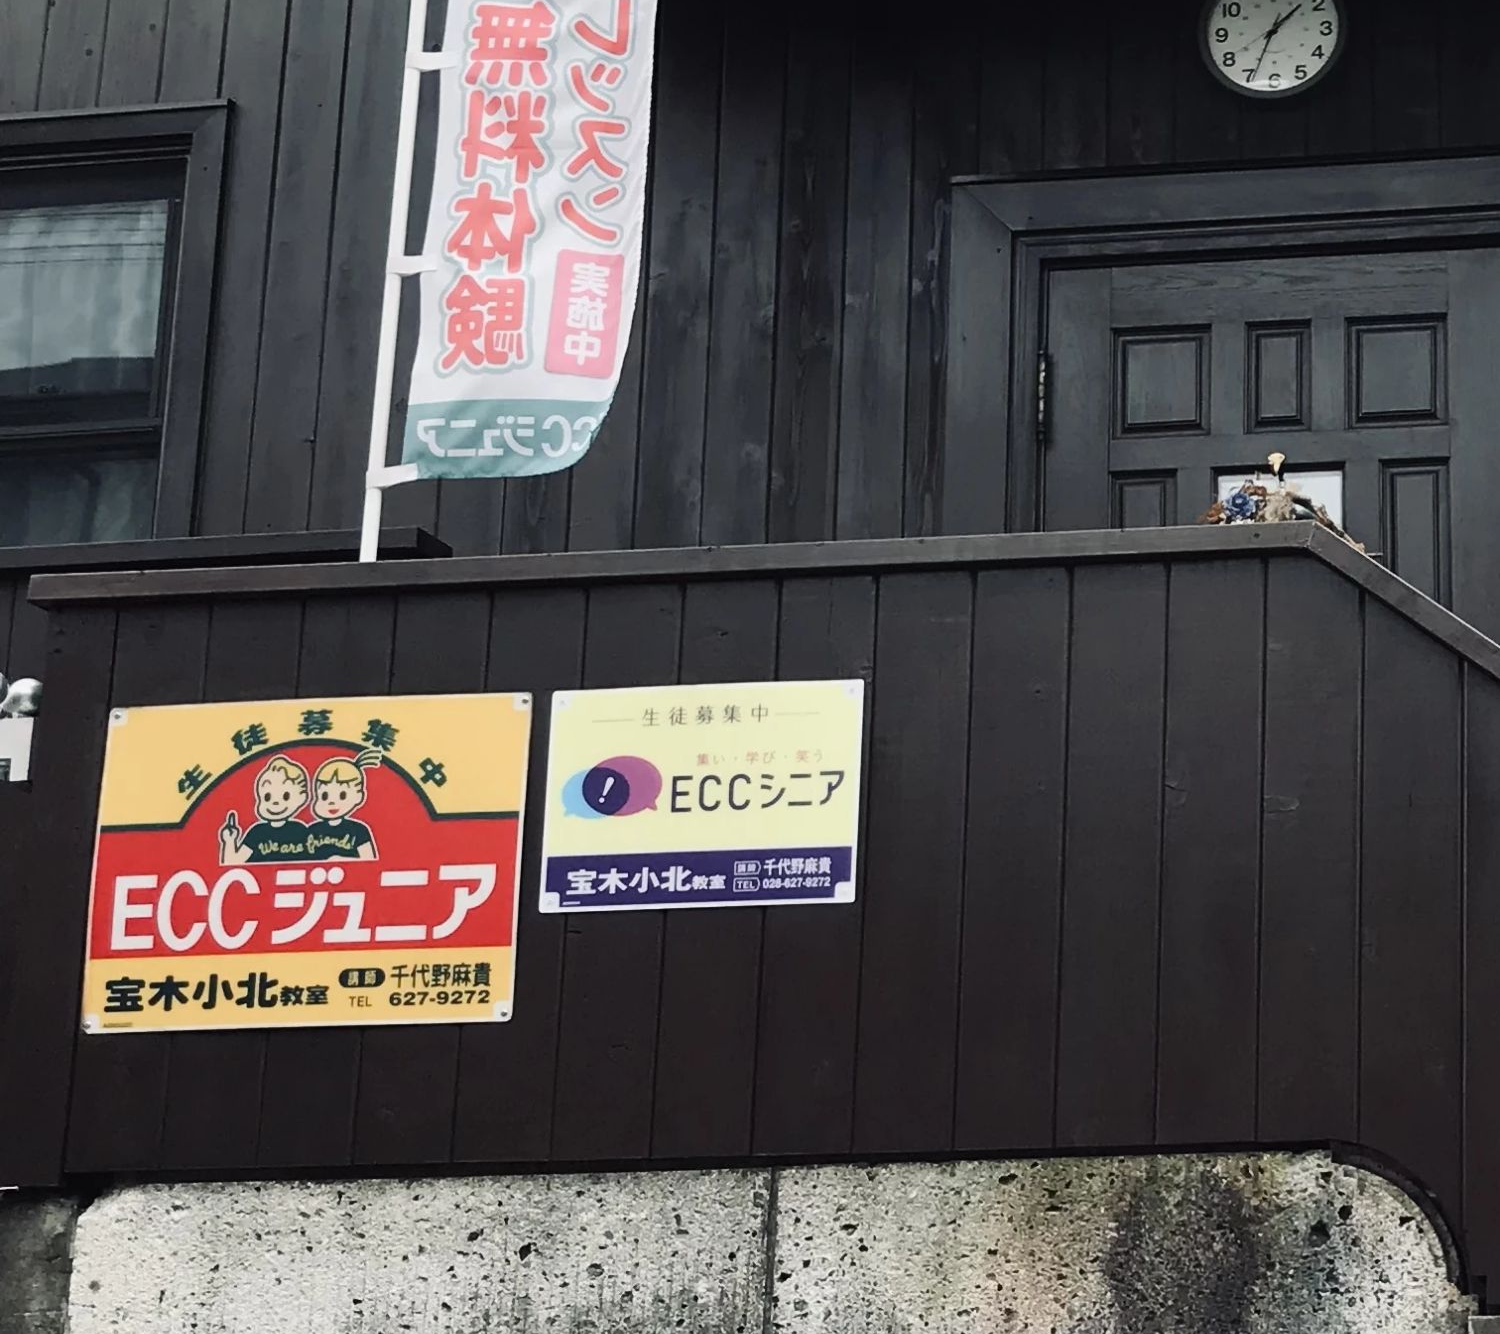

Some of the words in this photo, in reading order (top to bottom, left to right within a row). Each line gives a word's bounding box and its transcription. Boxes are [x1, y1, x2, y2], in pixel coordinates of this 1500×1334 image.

[1222, 2, 1241, 18] 10
[1215, 27, 1228, 43] 9
[1319, 20, 1333, 36] 3
[1222, 52, 1236, 67] 8
[1311, 44, 1324, 59] 4
[1242, 68, 1255, 83] 7
[1268, 73, 1281, 88] 6
[1294, 65, 1307, 80] 5
[642, 704, 769, 727] 生徒募集中
[177, 709, 448, 801] 生徒募集中
[671, 770, 845, 813] ECCシニア
[259, 840, 279, 855] We
[281, 843, 304, 853] are
[306, 834, 356, 854] friends!
[565, 866, 727, 896] 宝木小北教室
[736, 880, 756, 889] TEL
[762, 876, 831, 889] 028-627-9272
[110, 863, 497, 952] ECCジュニア
[390, 962, 492, 988] 千代野麻貴
[103, 972, 330, 1013] 宝木小北教室
[349, 995, 373, 1008] TEL
[389, 990, 491, 1007] 627-9272
